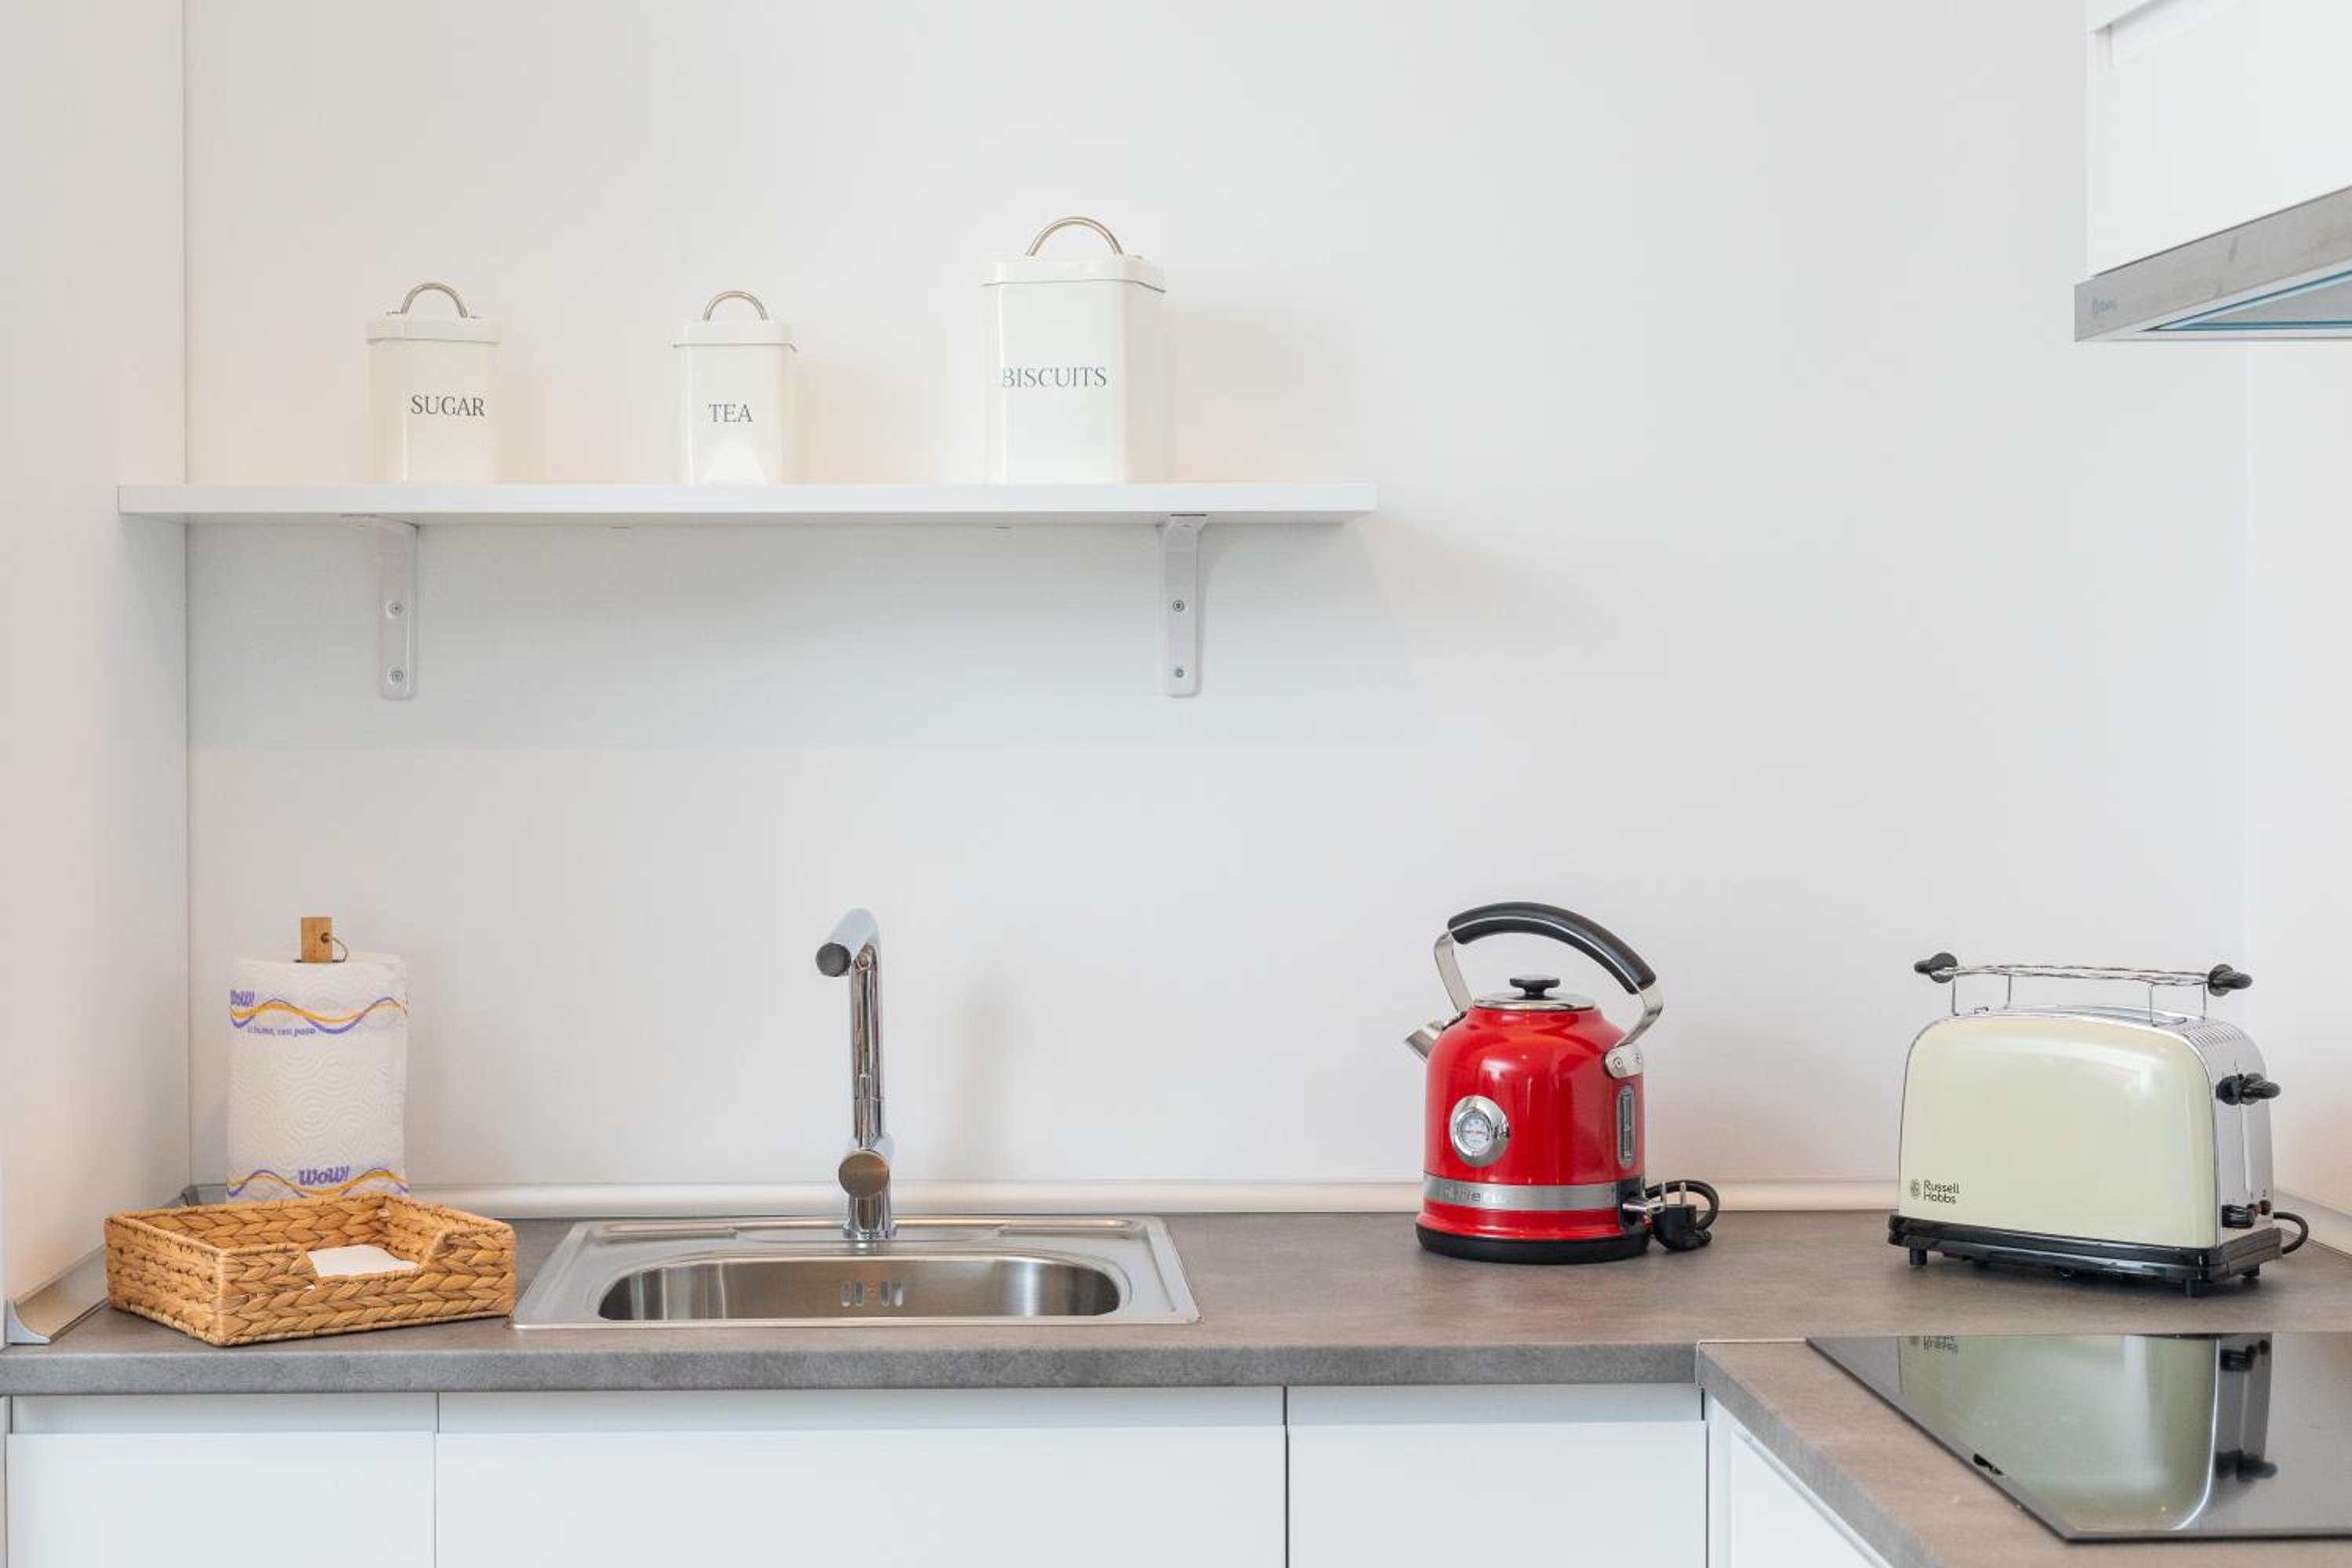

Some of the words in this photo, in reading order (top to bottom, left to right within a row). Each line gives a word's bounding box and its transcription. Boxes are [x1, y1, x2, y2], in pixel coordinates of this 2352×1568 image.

[1003, 366, 1106, 388] BISCUITS
[410, 394, 485, 416] SUGAR
[708, 403, 753, 423] TEA
[1923, 1179, 1959, 1194] Russell
[1923, 1191, 1956, 1204] Hobbs
